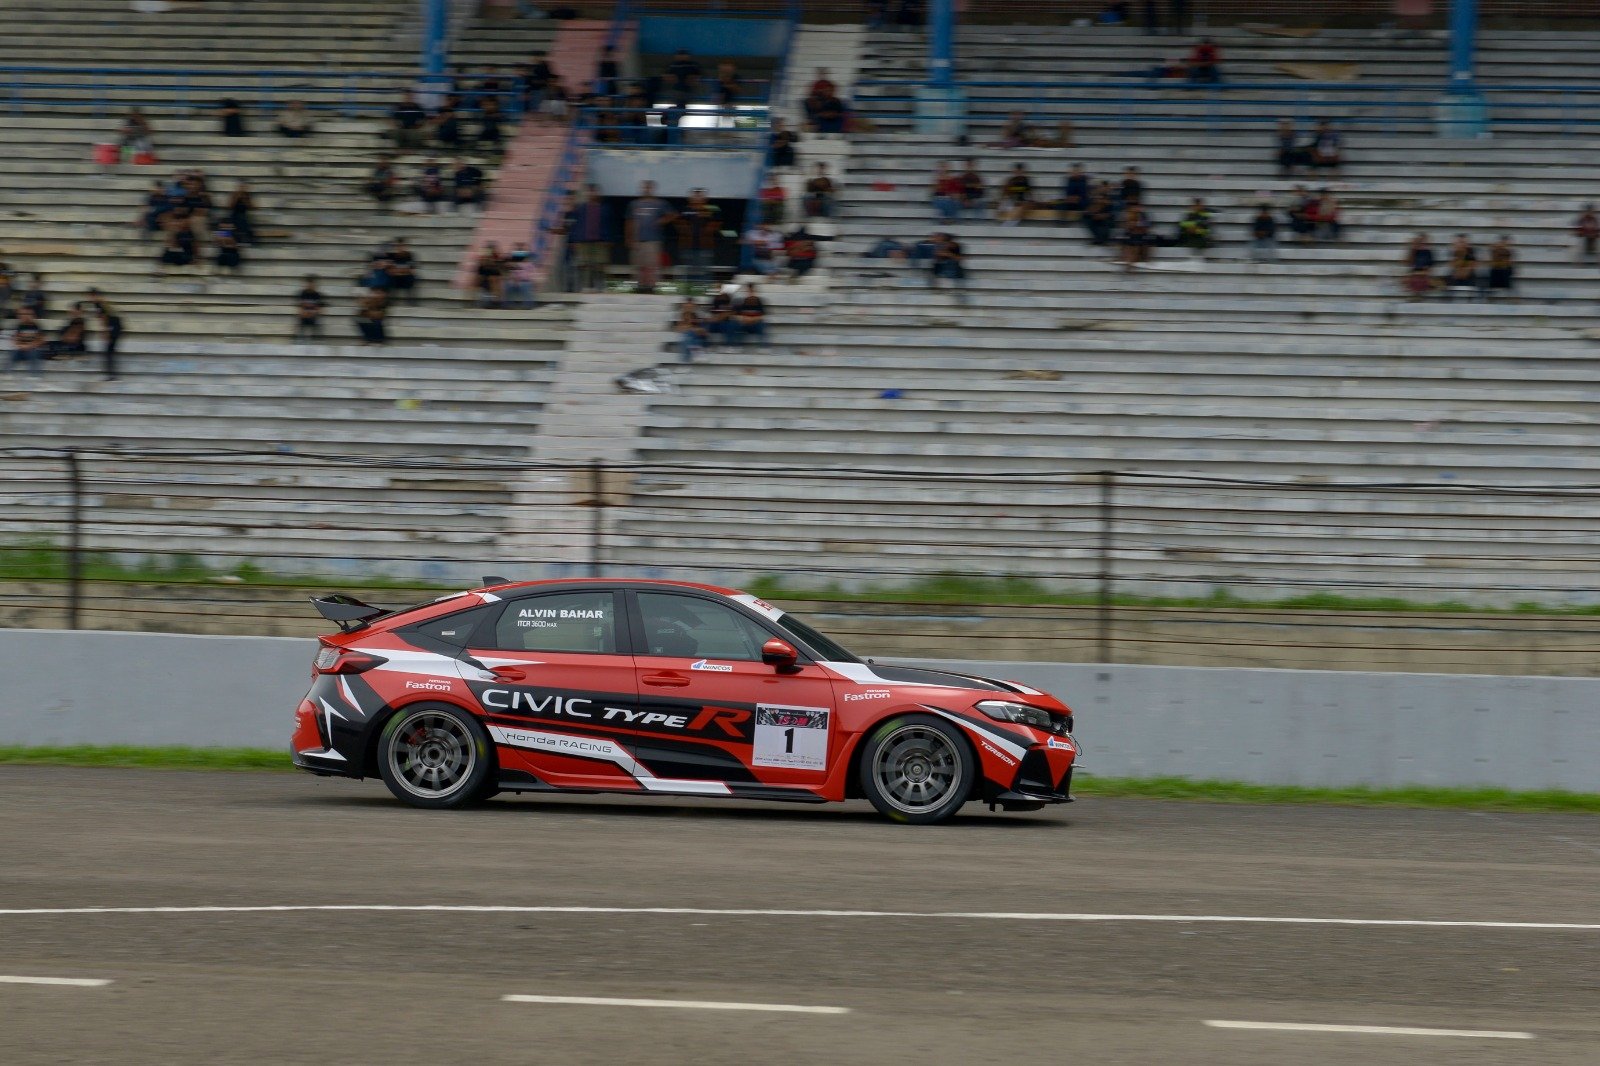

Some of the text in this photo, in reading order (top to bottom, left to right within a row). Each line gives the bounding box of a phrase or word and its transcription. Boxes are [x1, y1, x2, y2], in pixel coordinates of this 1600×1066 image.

[518, 608, 603, 619] ALVIN BAHAR
[531, 620, 547, 628] 3600
[405, 681, 451, 691] Fastron
[844, 692, 890, 702] Fastron
[481, 689, 592, 718] CIVIC
[603, 707, 688, 728] TYPE
[686, 705, 752, 738] R
[506, 732, 612, 753] Honda RACING
[784, 727, 795, 753] 1
[981, 740, 1016, 767] TORSION
